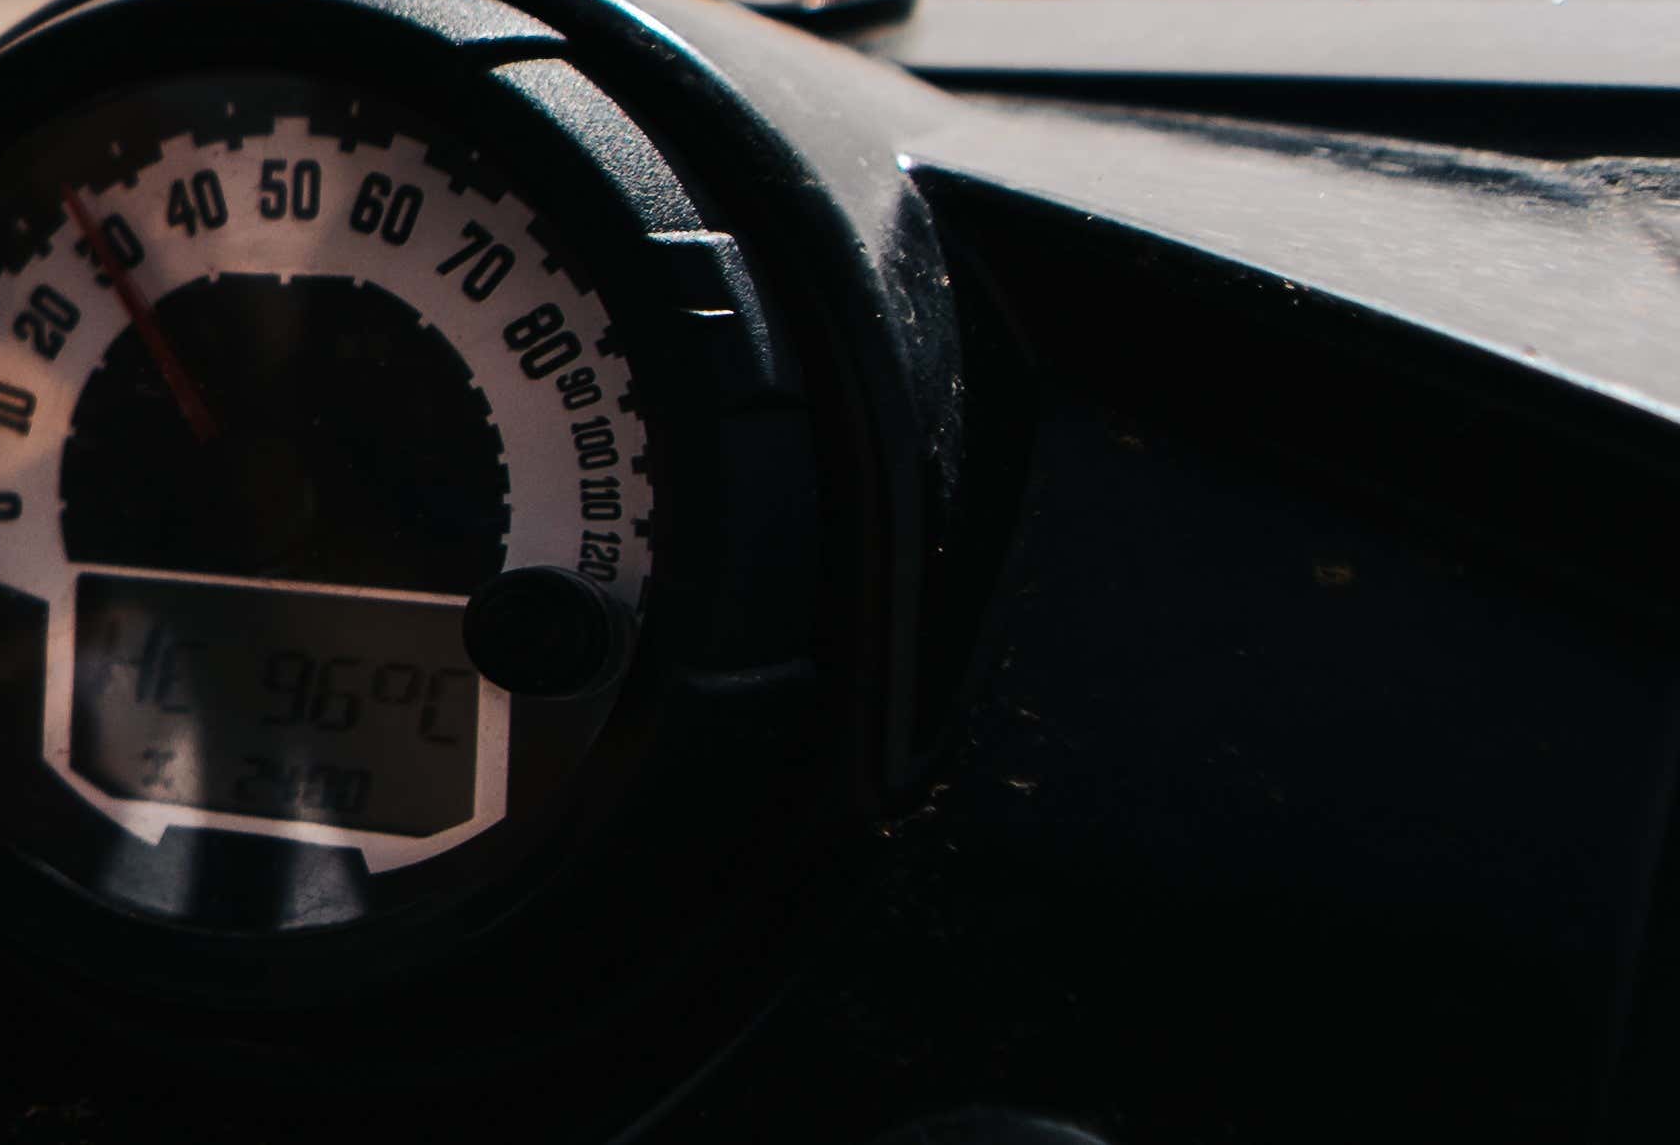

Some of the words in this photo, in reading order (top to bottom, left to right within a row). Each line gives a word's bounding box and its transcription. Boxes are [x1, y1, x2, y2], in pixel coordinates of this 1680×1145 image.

[167, 169, 227, 237] 40
[261, 160, 321, 220] 50
[350, 172, 424, 245] 60
[435, 220, 515, 301] 70
[13, 285, 81, 360] 20
[503, 302, 582, 380] 80
[555, 367, 602, 410] 90
[571, 416, 619, 470] 100
[579, 476, 622, 521] 110
[578, 530, 622, 582] 120
